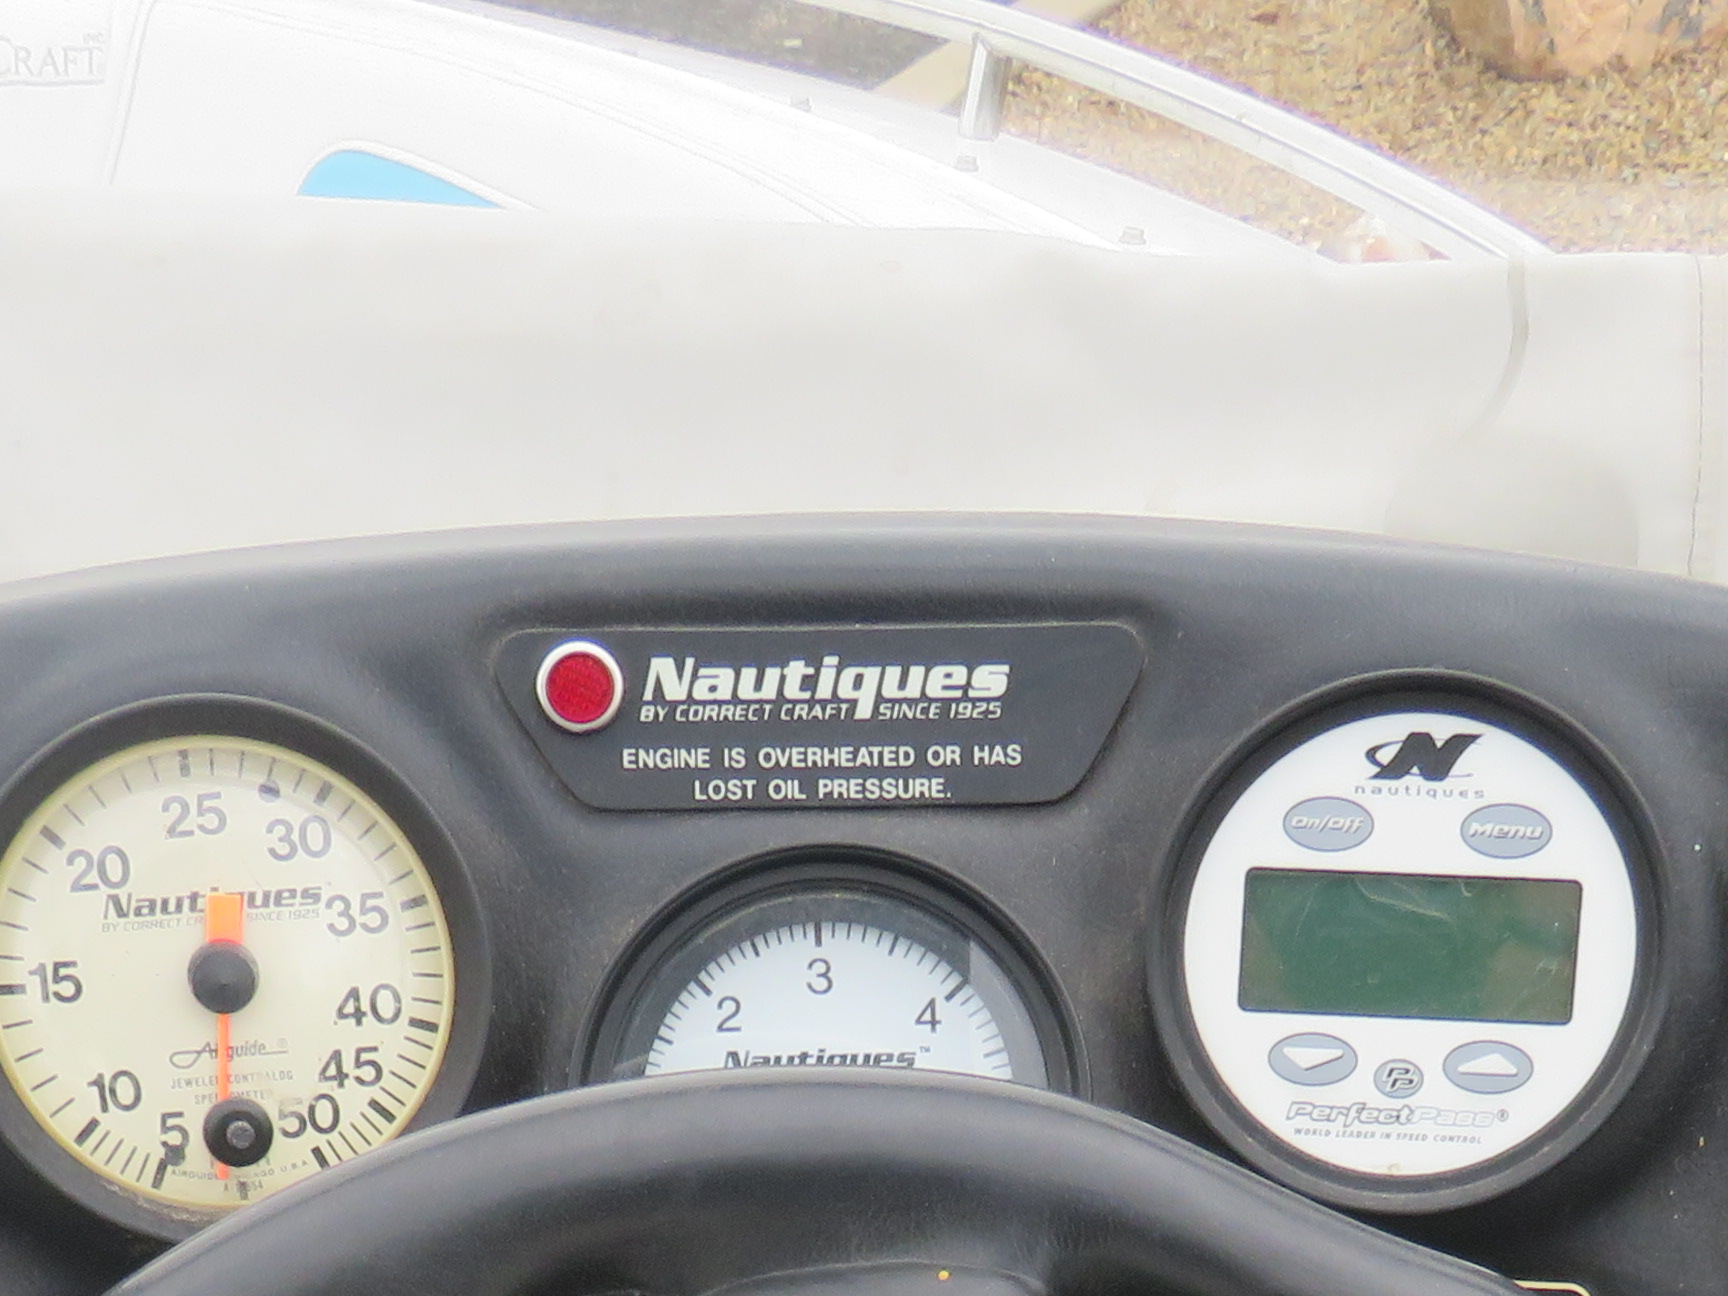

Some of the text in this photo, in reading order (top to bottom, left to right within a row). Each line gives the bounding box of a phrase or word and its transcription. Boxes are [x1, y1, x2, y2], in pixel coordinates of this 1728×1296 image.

[642, 655, 1011, 720] Nautiques
[639, 701, 1002, 722] BY CORRECT CRAFT SINCE 1925
[622, 744, 1022, 770] ENGINE IS OVERHEATED OR HAS
[693, 777, 952, 801] LOST OIL PRESSURE.
[1354, 784, 1485, 800] nautiques
[162, 791, 228, 839] 25
[1468, 821, 1543, 841] Menu
[266, 815, 331, 862] 30
[66, 845, 130, 893] 20
[102, 922, 119, 933] BY
[123, 919, 181, 932] CORRECT
[288, 908, 320, 920] 1925
[103, 886, 323, 919] Nautues
[326, 892, 389, 937] 35
[29, 960, 83, 1004] 15
[805, 958, 834, 995] 3
[335, 983, 402, 1027] 40
[715, 997, 743, 1032] 2
[914, 997, 942, 1033] 4
[319, 1046, 384, 1089] 45
[87, 1070, 142, 1112] 10
[160, 1112, 190, 1150] 5
[278, 1093, 340, 1140] 50
[1294, 1127, 1482, 1145] WORLD LEADER IN SPEED CONTROL
